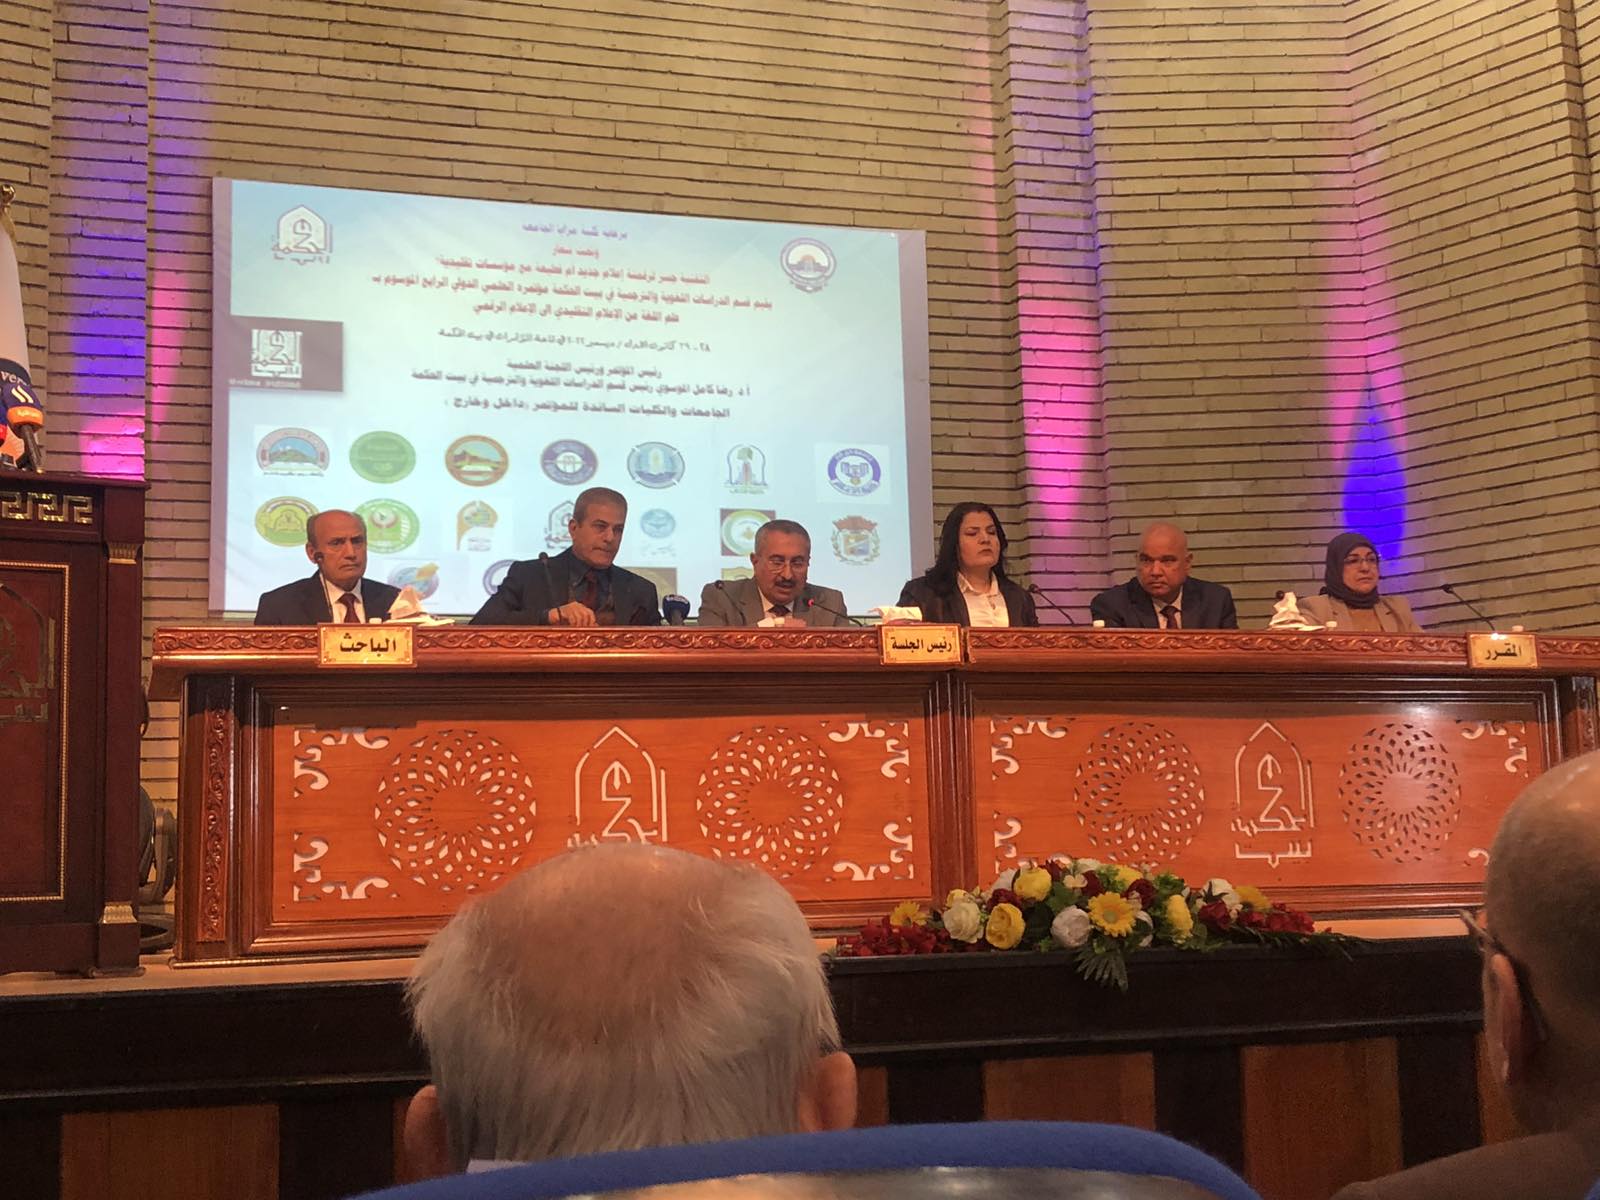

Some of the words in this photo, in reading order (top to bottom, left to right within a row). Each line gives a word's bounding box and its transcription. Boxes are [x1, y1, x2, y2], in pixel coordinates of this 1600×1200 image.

[340, 632, 396, 657] الباحث
[890, 637, 924, 653] الجلسة
[926, 637, 952, 653] رئيس
[1485, 642, 1522, 660] المقرر
